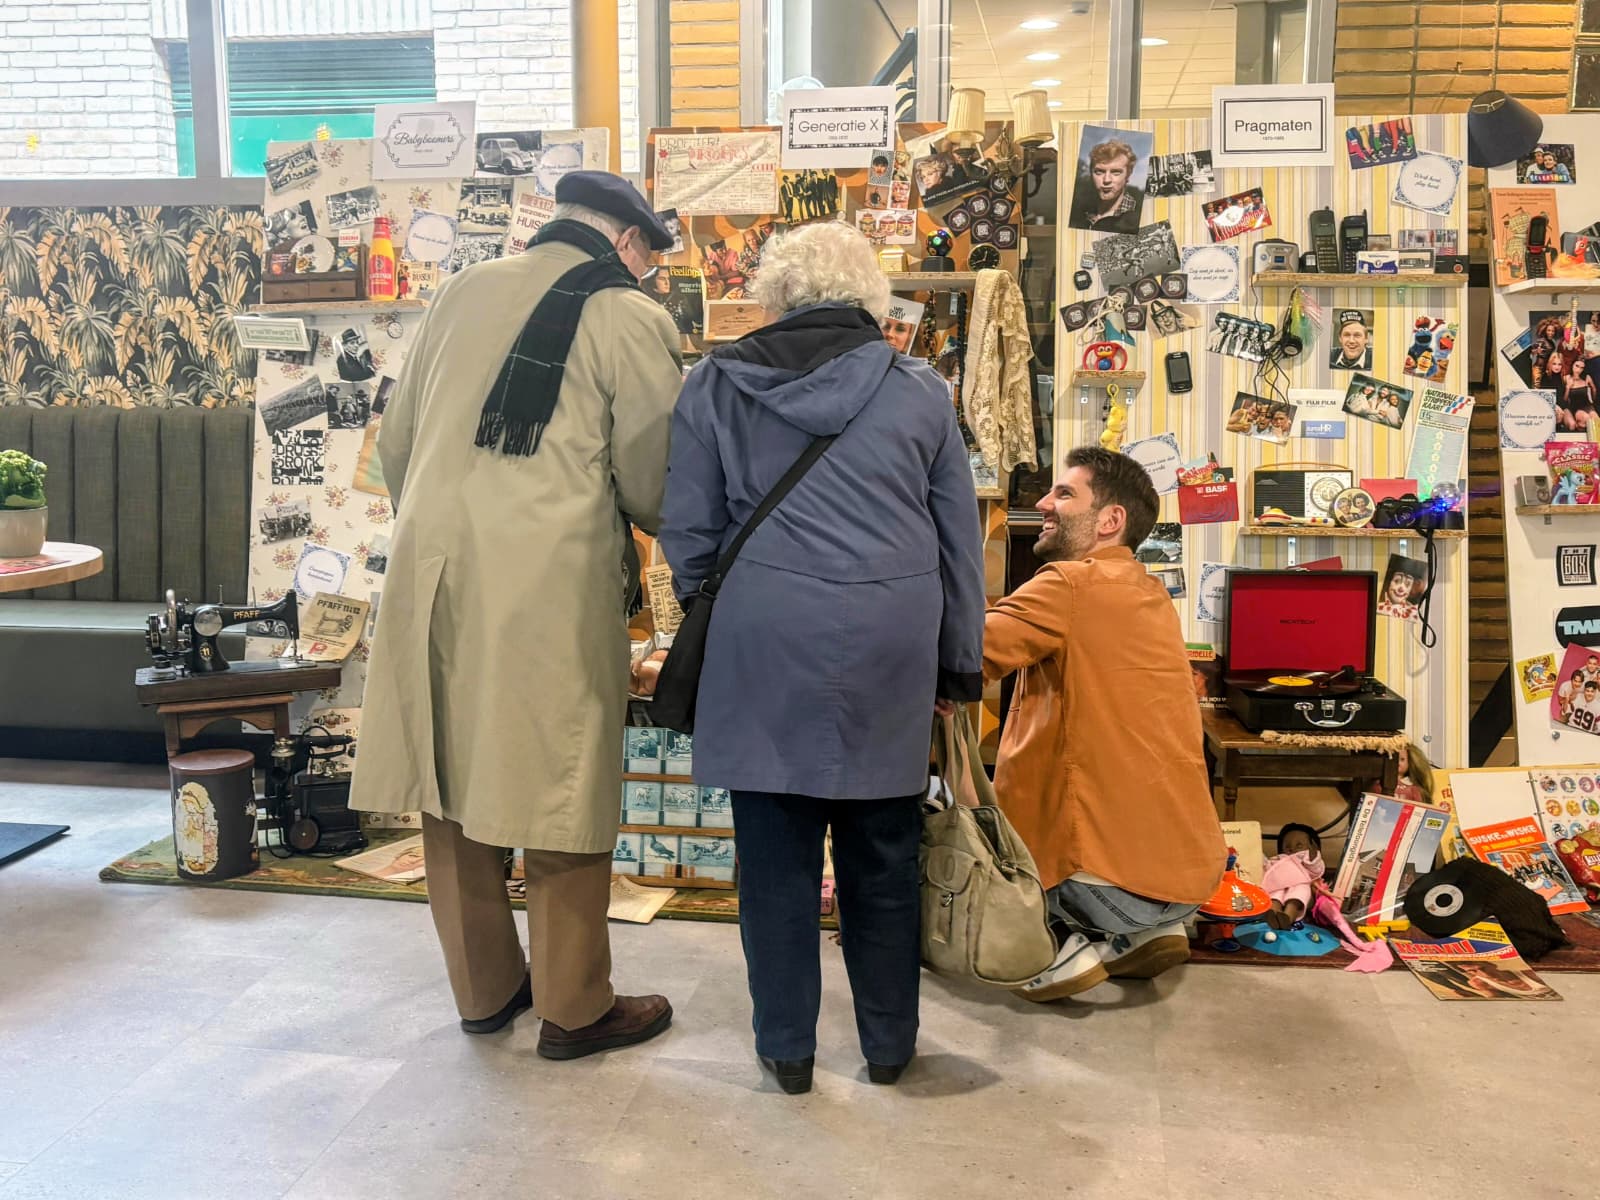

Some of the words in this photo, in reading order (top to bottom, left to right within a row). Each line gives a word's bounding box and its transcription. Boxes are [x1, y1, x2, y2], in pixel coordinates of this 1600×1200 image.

[798, 119, 866, 133] Generatie
[870, 119, 879, 131] X
[1234, 119, 1313, 135] Pragmaten
[393, 132, 455, 148] Babyboomers
[1423, 395, 1452, 407] STRIPPEN
[1425, 388, 1458, 401] NATIONALE
[1422, 402, 1443, 411] KAART
[1551, 454, 1591, 465] CLASSIC
[1205, 485, 1228, 493] BASF
[1563, 554, 1588, 576] BOX
[316, 599, 342, 610] PFAFF
[233, 609, 260, 620] PFAFF
[1573, 707, 1594, 731] 99
[1469, 831, 1501, 845] SUSKE
[1506, 825, 1538, 838] WISKE
